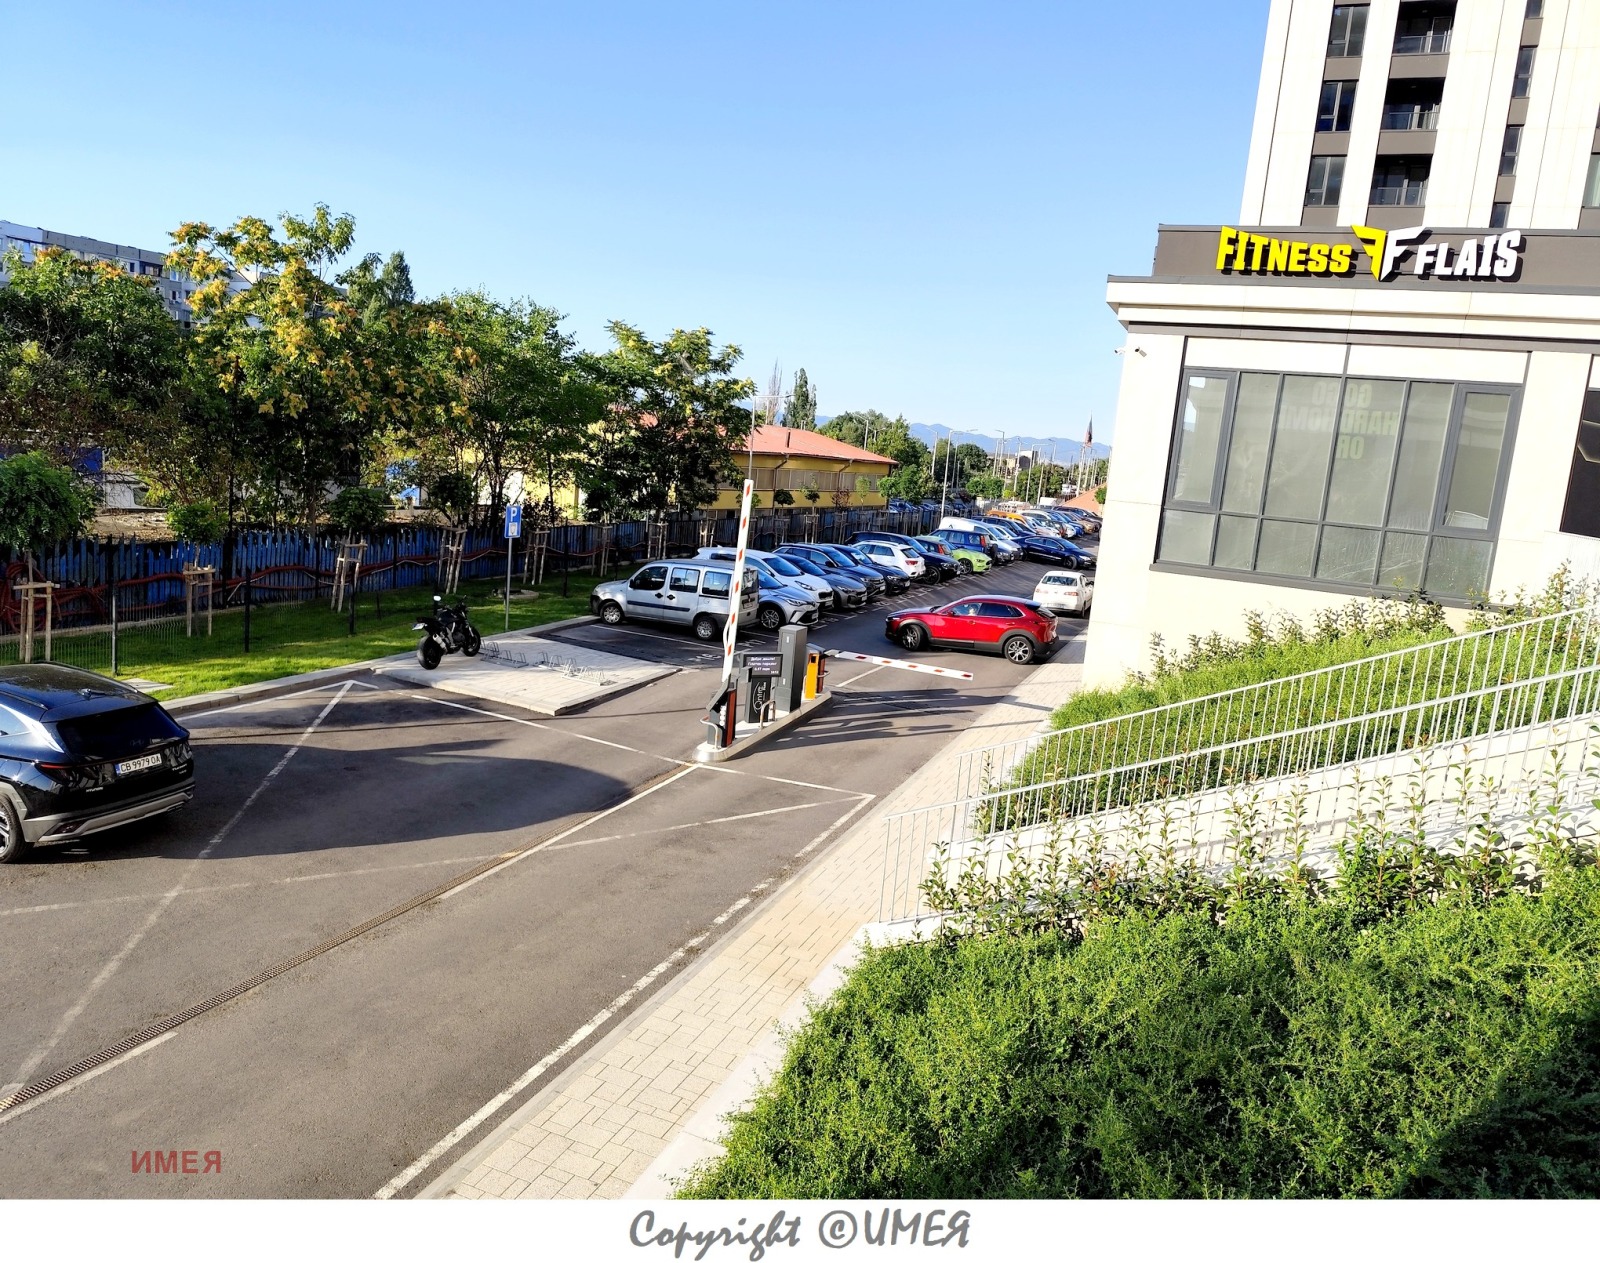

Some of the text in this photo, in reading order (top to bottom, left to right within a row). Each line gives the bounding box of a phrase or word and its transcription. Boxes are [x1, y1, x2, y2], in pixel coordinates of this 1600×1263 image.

[1216, 225, 1352, 272] FITNESS
[1414, 230, 1521, 277] FLAIS
[510, 507, 518, 523] P
[132, 757, 150, 769] 9979
